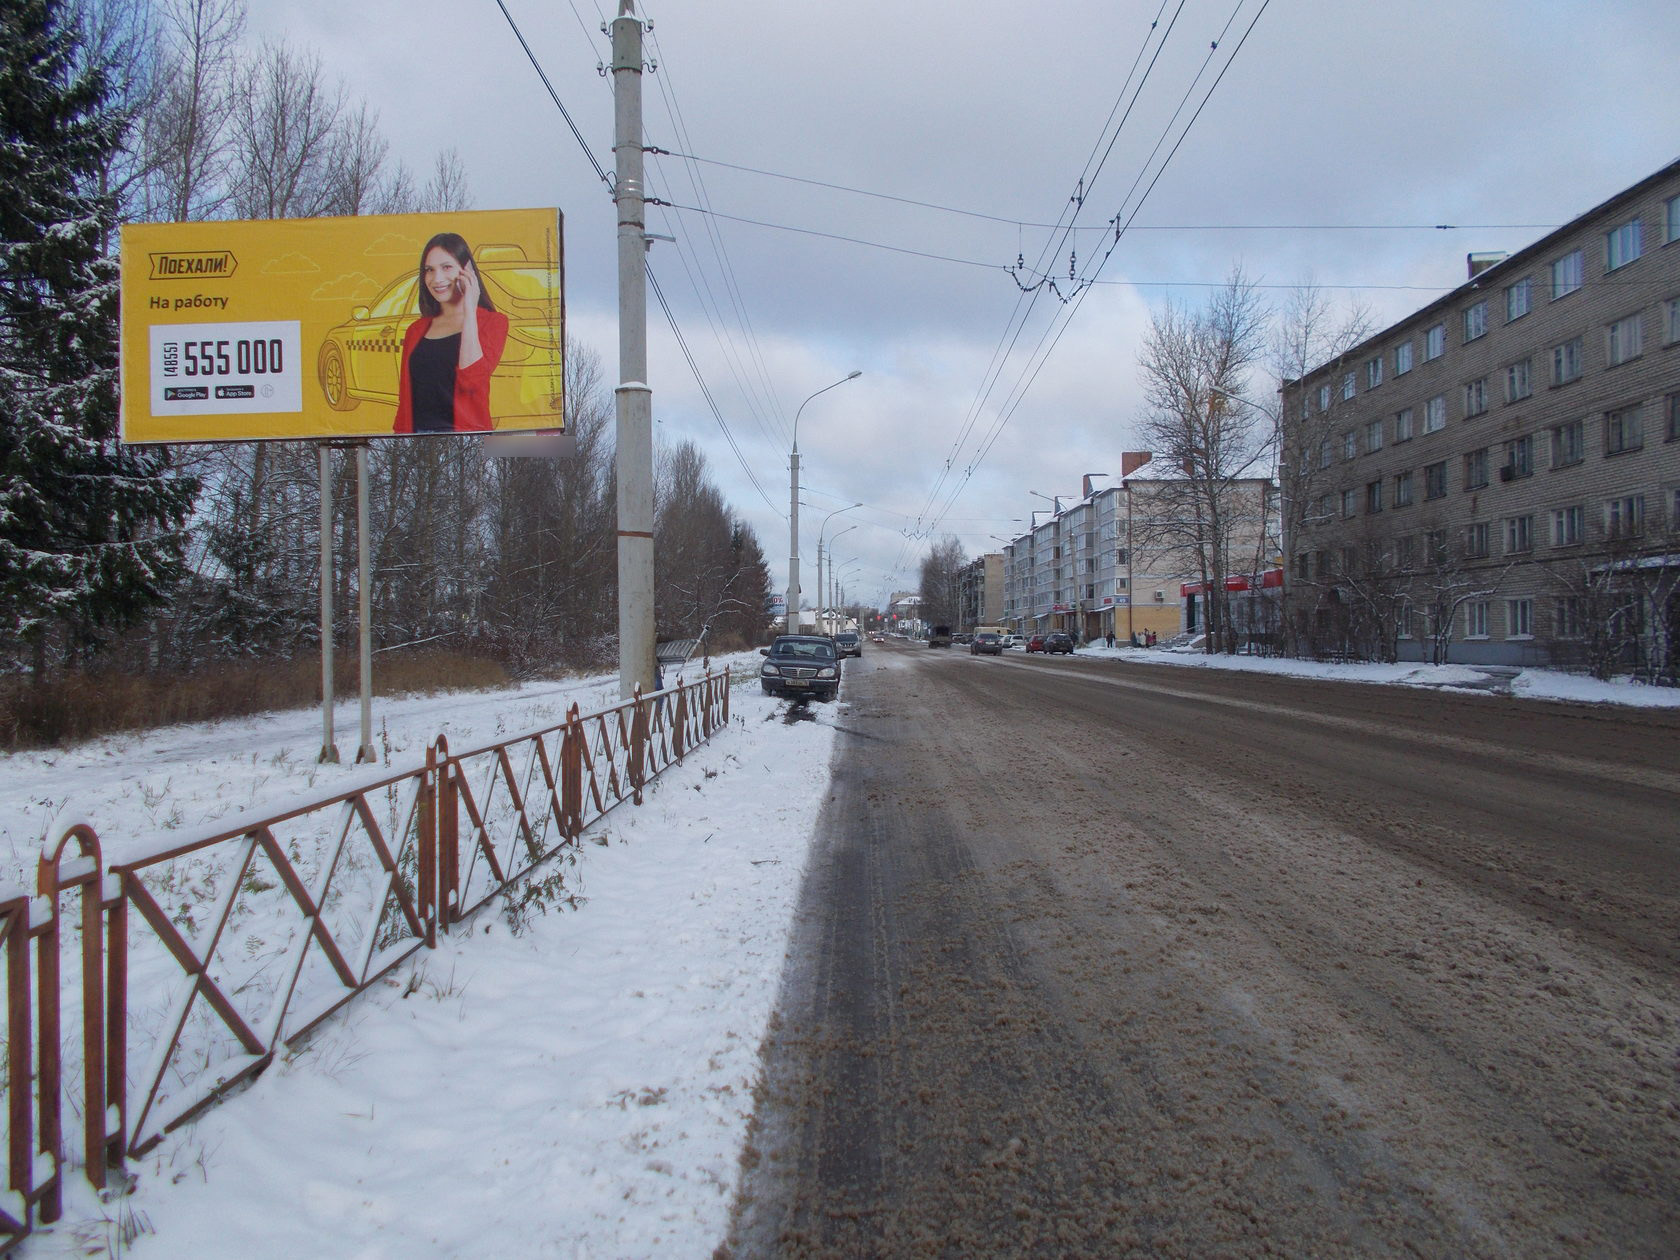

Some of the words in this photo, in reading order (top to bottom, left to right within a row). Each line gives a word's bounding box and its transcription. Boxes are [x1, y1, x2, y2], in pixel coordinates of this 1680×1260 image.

[149, 295, 170, 309] На
[174, 293, 229, 311] работу
[164, 342, 178, 377] (4855)
[184, 341, 230, 376] 555
[237, 339, 283, 374] 000
[177, 391, 196, 399] Google
[196, 391, 207, 399] Play
